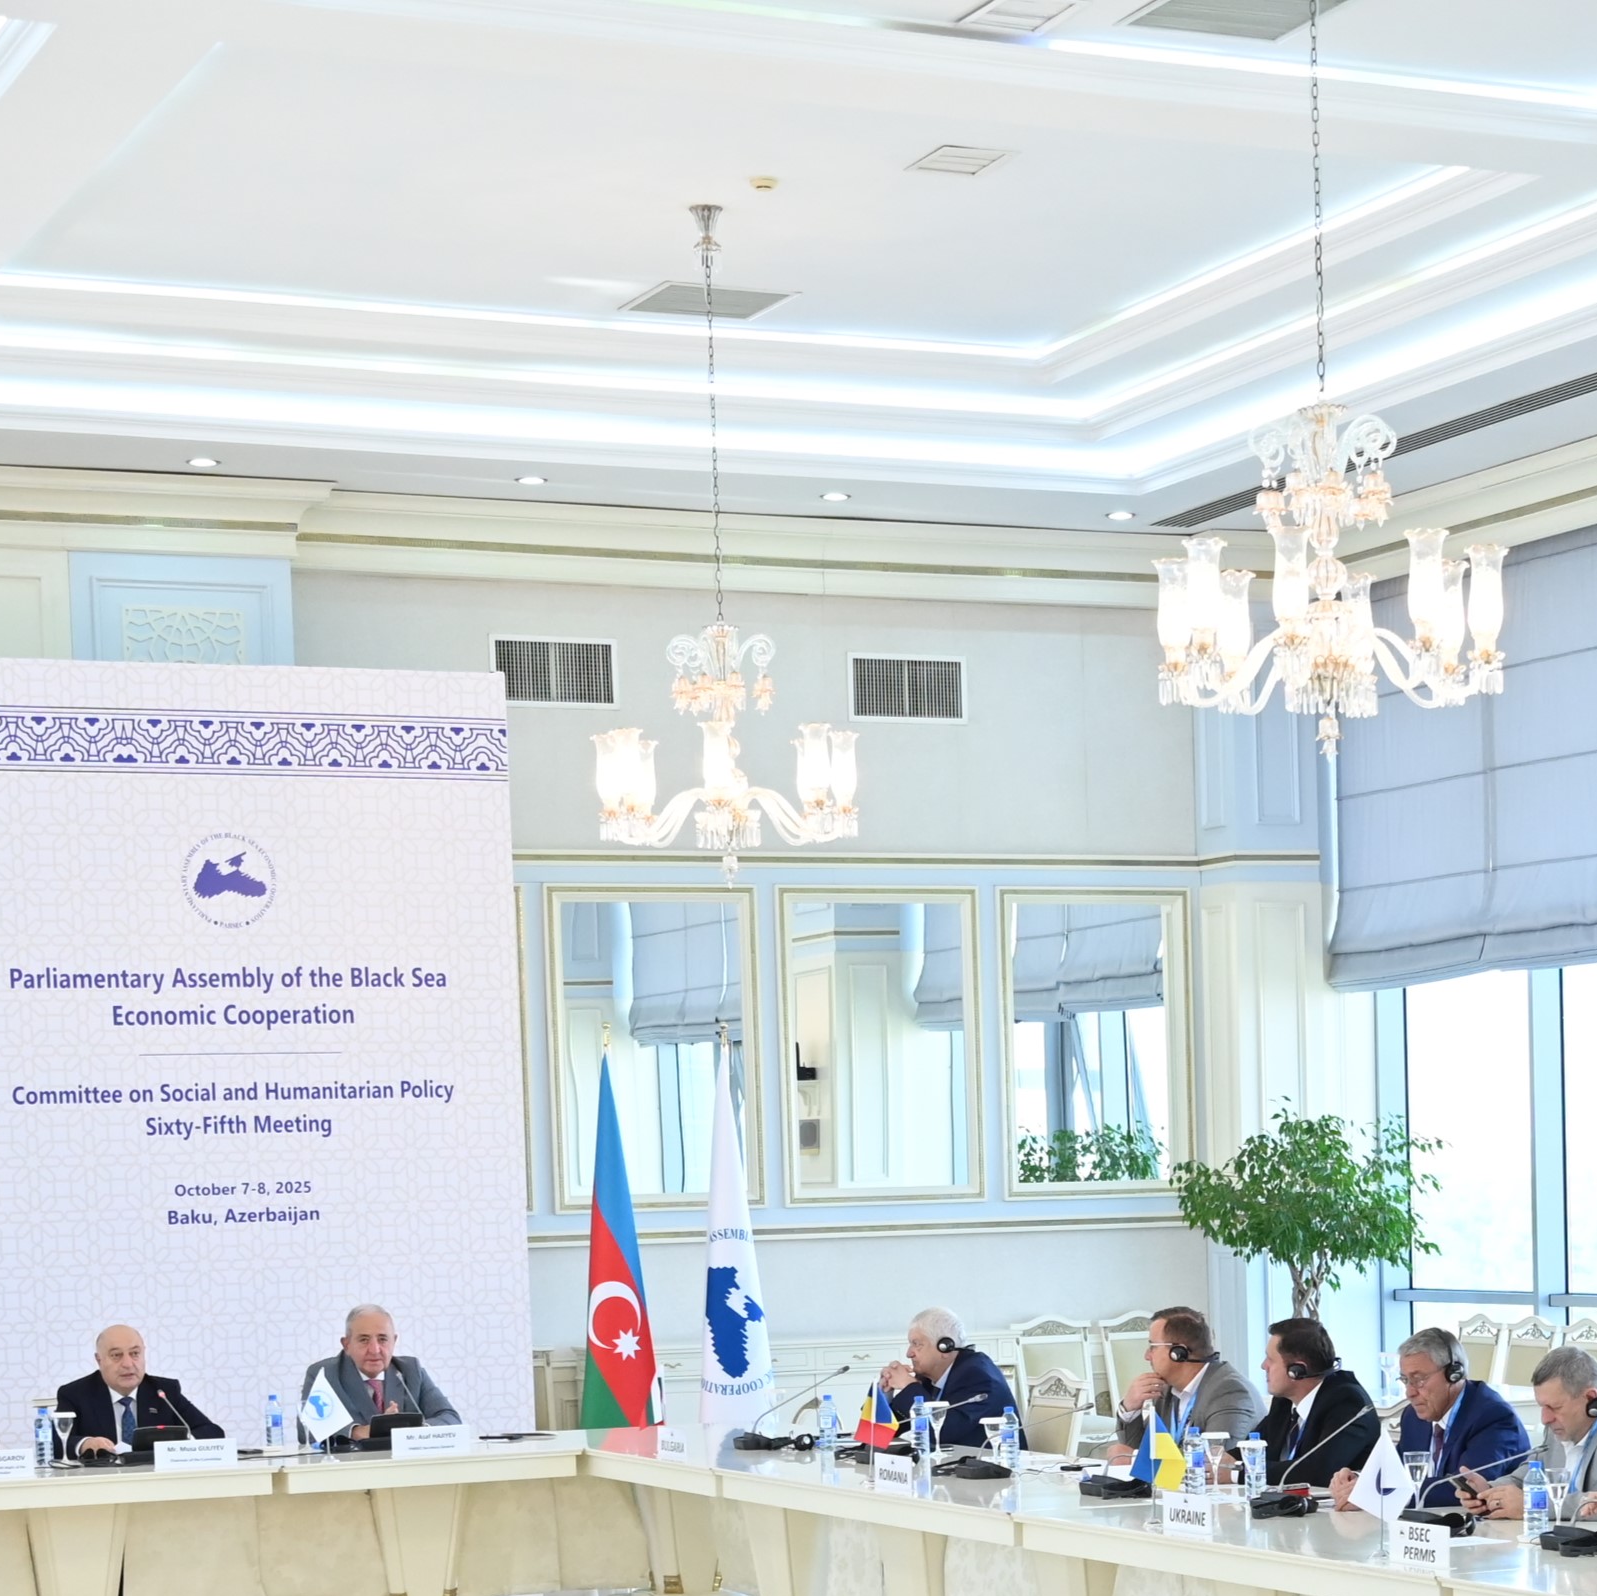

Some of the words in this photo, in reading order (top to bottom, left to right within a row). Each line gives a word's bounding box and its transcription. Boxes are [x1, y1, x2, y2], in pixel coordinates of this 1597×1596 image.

[10, 967, 164, 994] Parliamentary
[172, 967, 274, 993] Assembly
[281, 966, 302, 987] of
[309, 967, 343, 987] the
[351, 967, 405, 987] Black
[412, 968, 446, 987] Sea
[113, 1004, 216, 1025] Economic
[224, 1004, 354, 1030] Cooperation
[13, 1085, 122, 1105] Committee
[129, 1089, 153, 1103] on
[160, 1082, 216, 1102] Social
[223, 1082, 257, 1101] and
[266, 1081, 393, 1100] Humanitarian
[401, 1080, 454, 1103] Policy
[146, 1115, 246, 1140] Sixty-Fifth
[254, 1114, 331, 1137] Meeting
[175, 1183, 236, 1196] October
[242, 1182, 269, 1195] 7-8,
[276, 1181, 311, 1193] 2025
[168, 1209, 217, 1225] Baku,
[225, 1207, 319, 1225] Azerbaijan
[879, 1468, 908, 1484] ROMANIA
[1169, 1508, 1206, 1526] UKRAINE
[1408, 1526, 1431, 1543] BSEC
[1404, 1546, 1436, 1563] PERMIS
